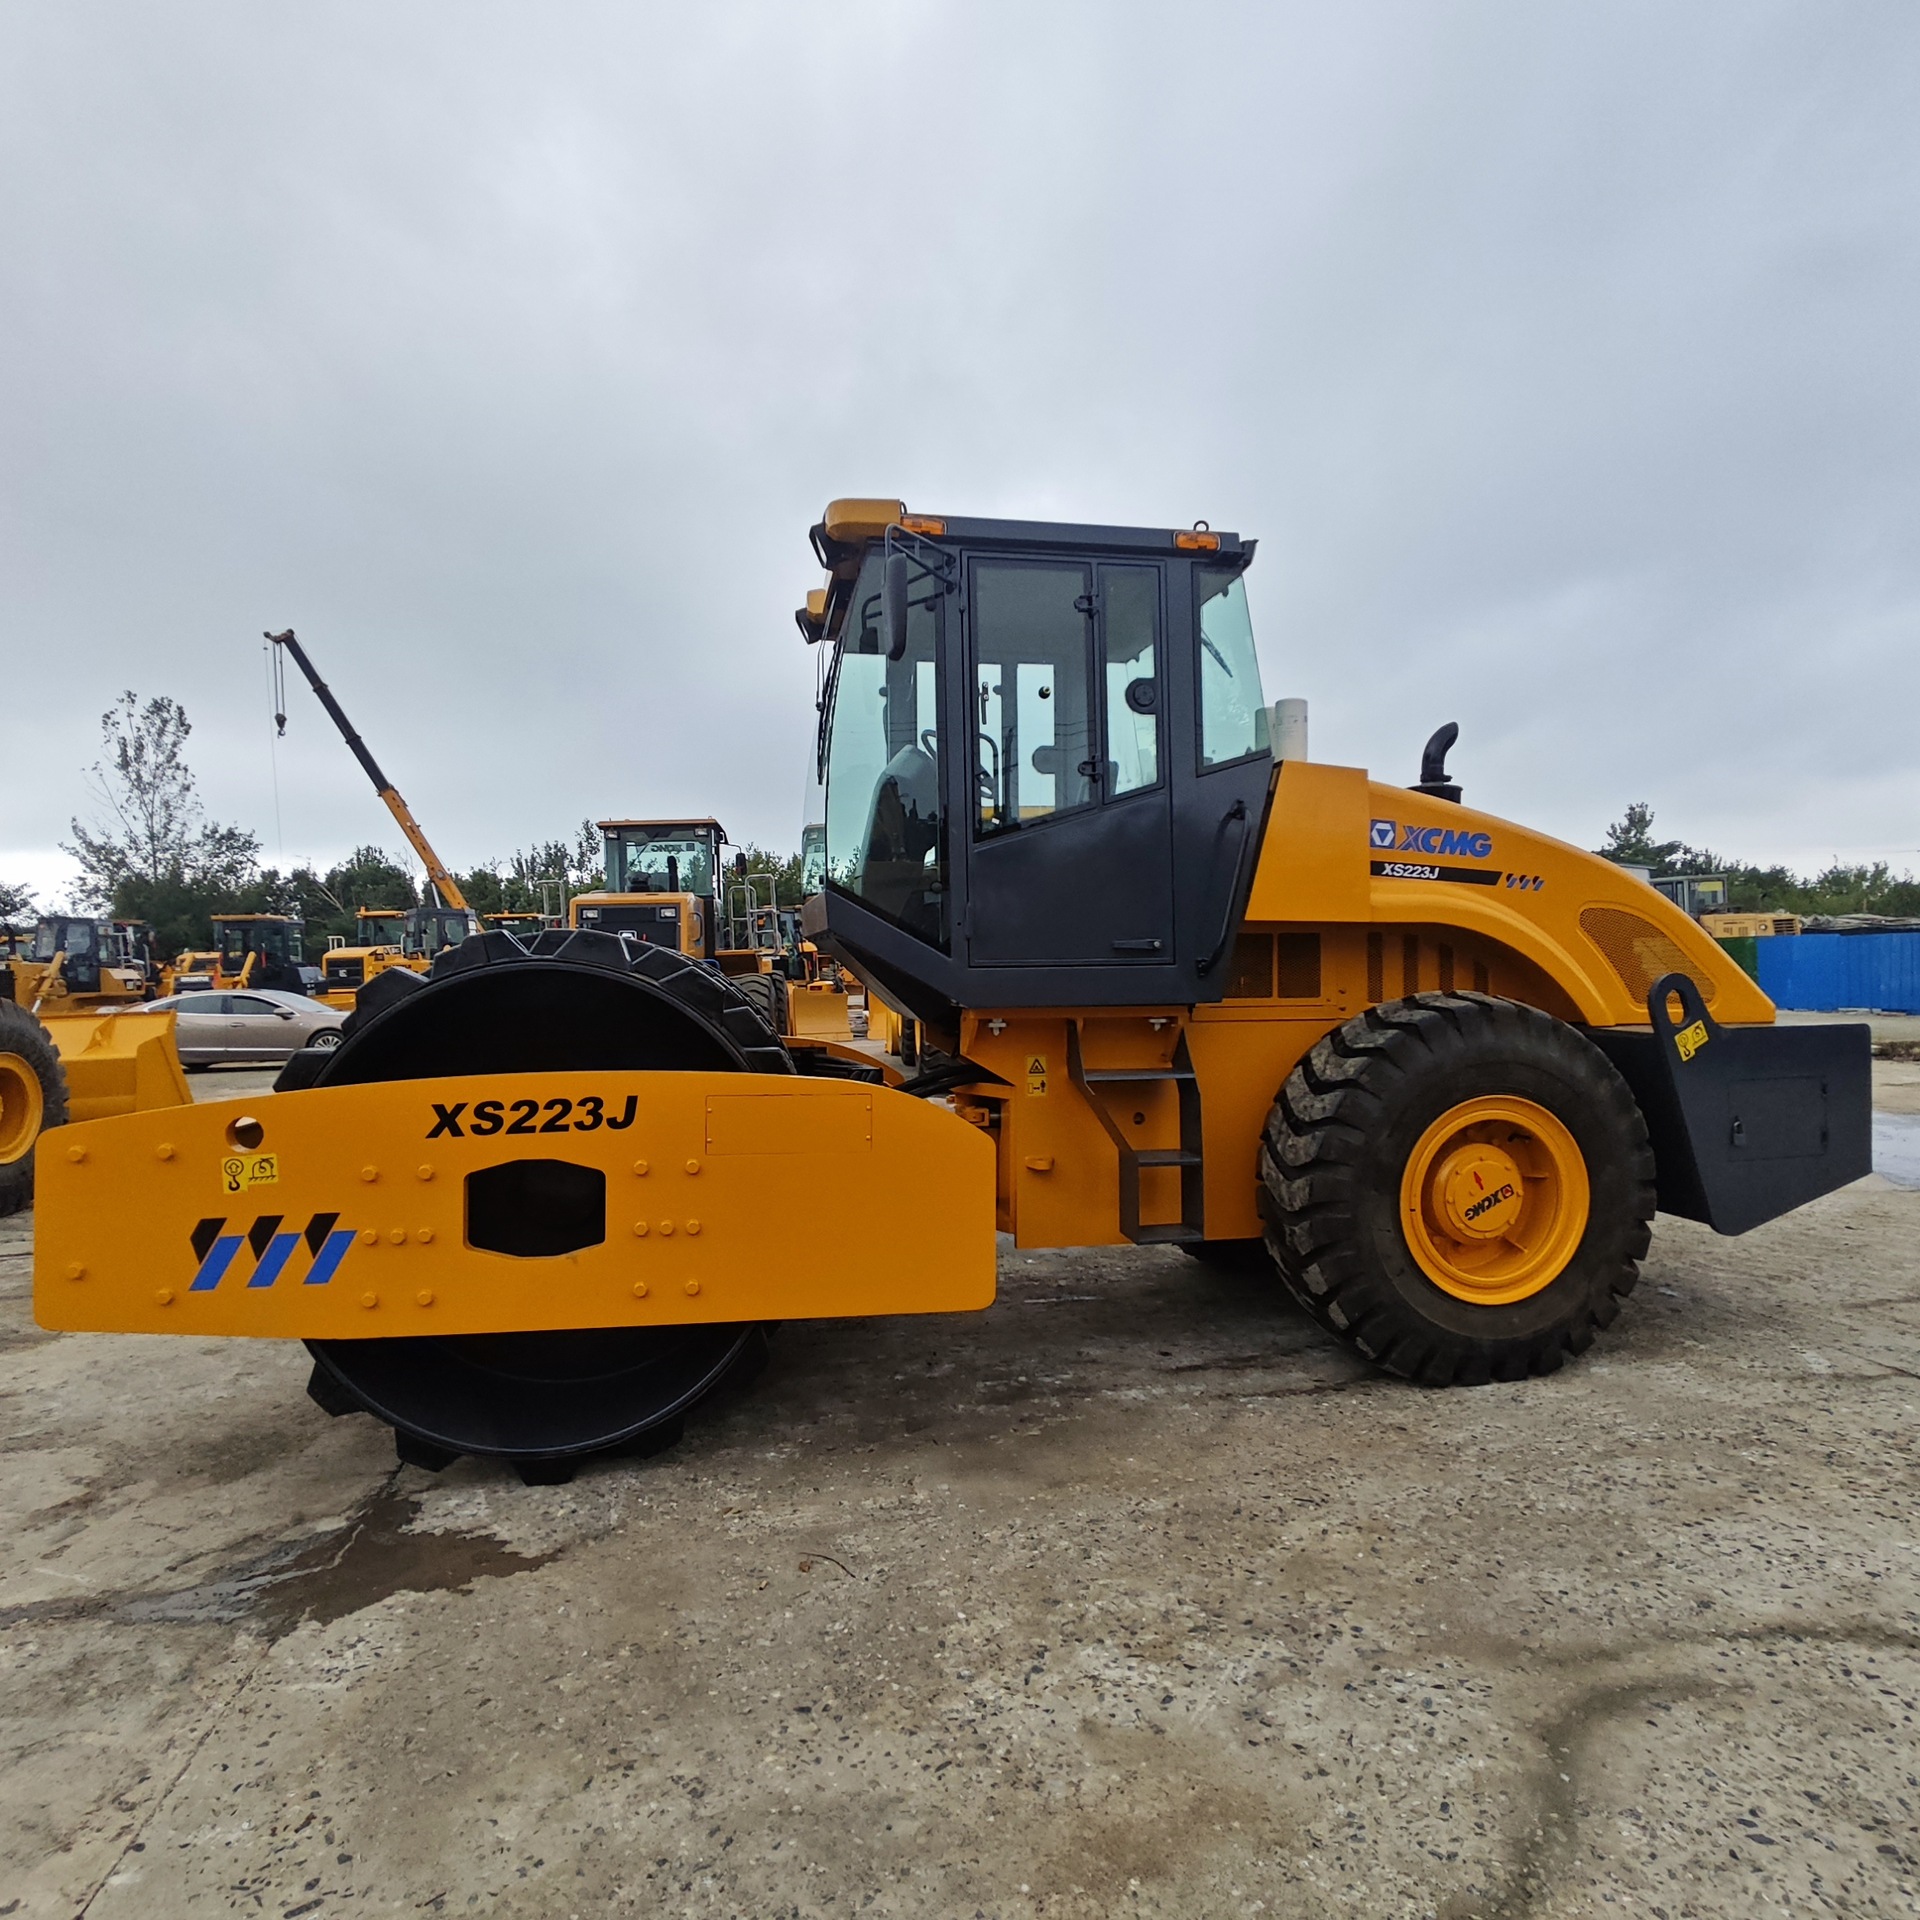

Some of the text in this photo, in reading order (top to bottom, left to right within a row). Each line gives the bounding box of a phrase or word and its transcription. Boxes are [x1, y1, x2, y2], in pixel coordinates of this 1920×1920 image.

[1396, 825, 1492, 858] XCMG
[1382, 863, 1440, 879] XS223J
[425, 1095, 639, 1139] XS223J
[1465, 1190, 1502, 1221] XCMG
